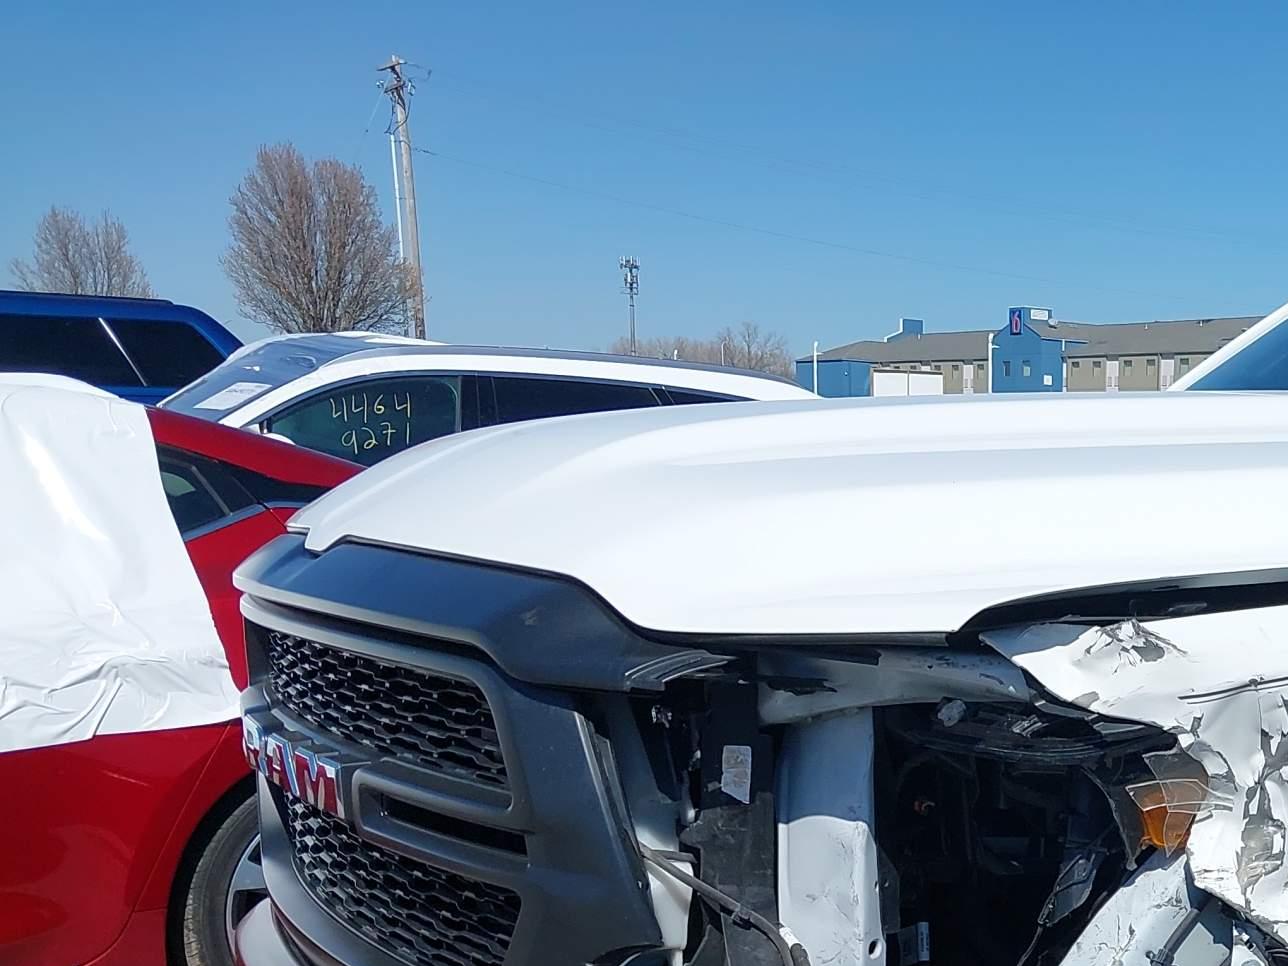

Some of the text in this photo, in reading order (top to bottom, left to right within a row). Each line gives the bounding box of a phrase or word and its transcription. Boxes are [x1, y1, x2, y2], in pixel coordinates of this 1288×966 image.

[329, 391, 411, 424] 4464
[341, 421, 411, 455] 9271
[243, 714, 345, 819] RAM
